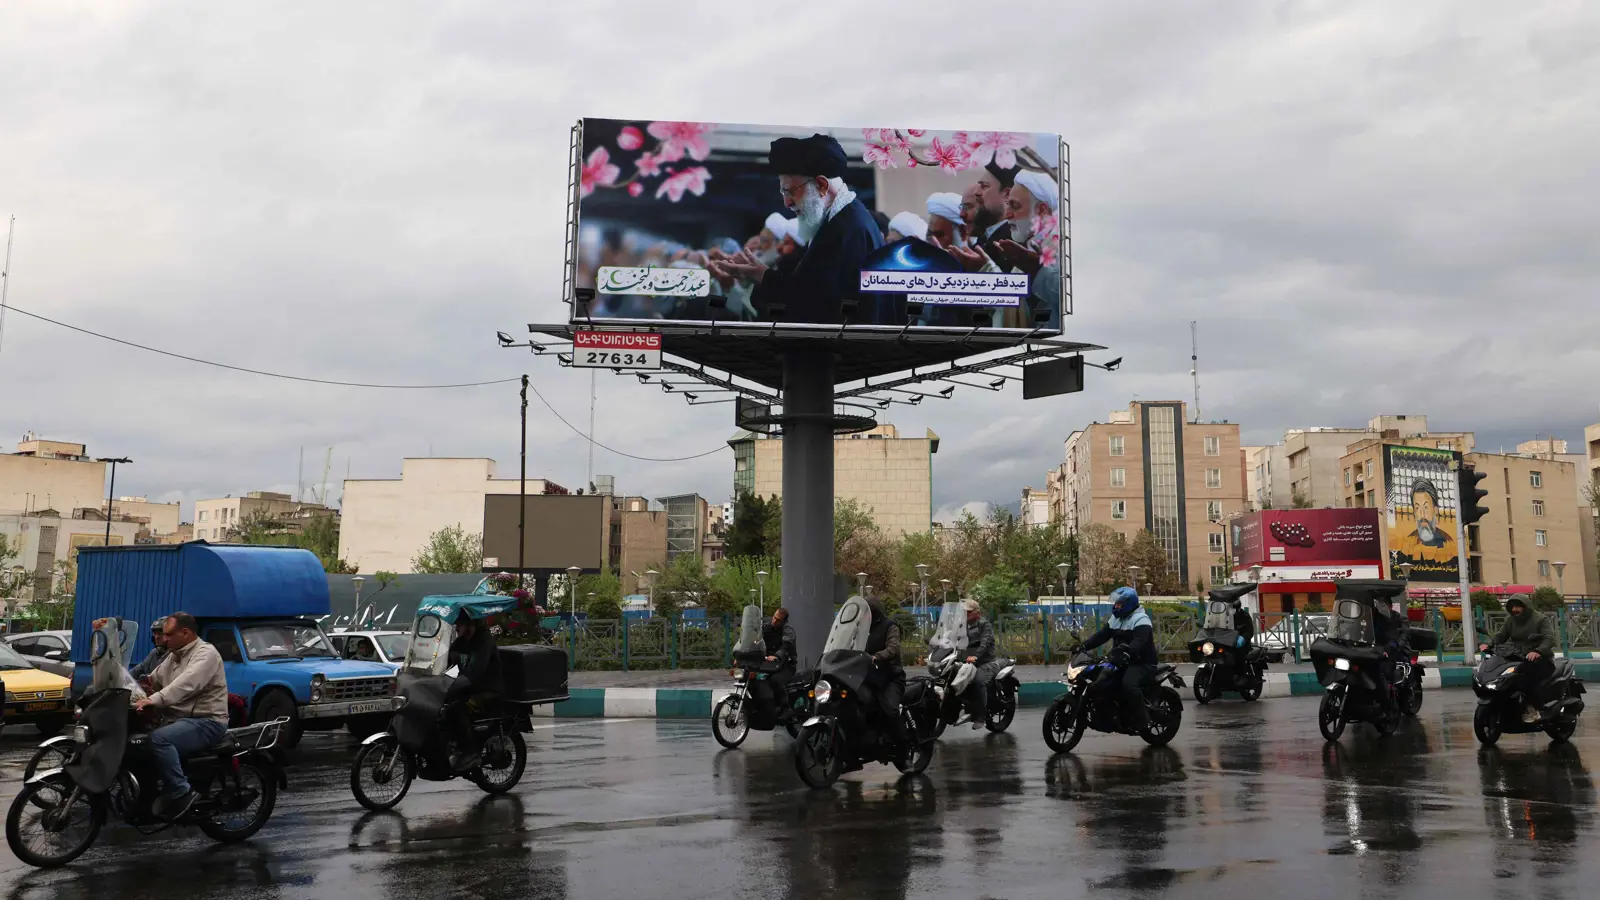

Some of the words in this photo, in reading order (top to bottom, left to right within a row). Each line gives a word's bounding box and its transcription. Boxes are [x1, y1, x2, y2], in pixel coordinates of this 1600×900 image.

[600, 264, 651, 292] لبخند
[654, 275, 689, 292] رحمت
[861, 275, 906, 288] مسلمانان
[939, 276, 970, 290] نزدیکی
[970, 276, 987, 290] عید
[1009, 277, 1027, 290] عید
[646, 281, 653, 291] و
[686, 279, 706, 299] عید
[577, 333, 601, 345] نوین
[602, 334, 625, 345] ایران
[626, 335, 659, 346] کانون
[586, 352, 647, 365] 27634
